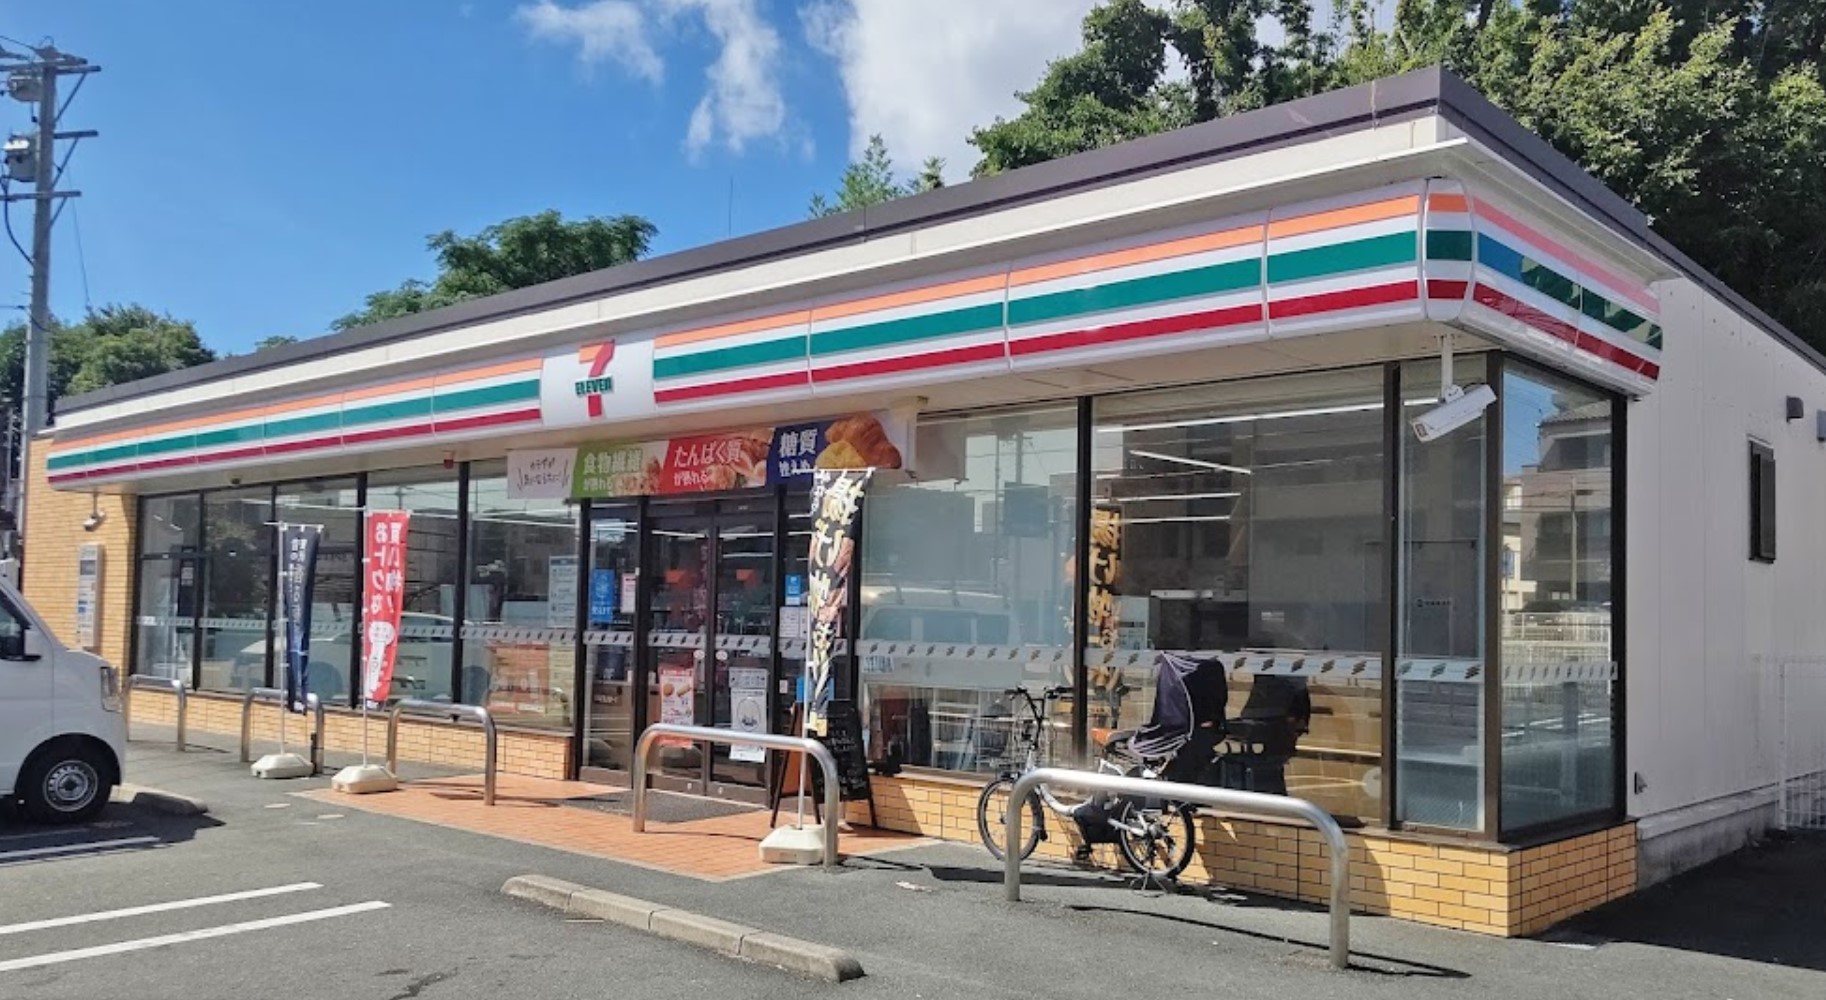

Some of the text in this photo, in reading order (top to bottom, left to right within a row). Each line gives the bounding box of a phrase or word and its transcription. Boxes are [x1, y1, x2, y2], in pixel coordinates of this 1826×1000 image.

[579, 339, 615, 417] 7
[674, 438, 742, 467] たんぱく質
[779, 428, 818, 458] 糖質
[583, 449, 642, 475] 食物繊維
